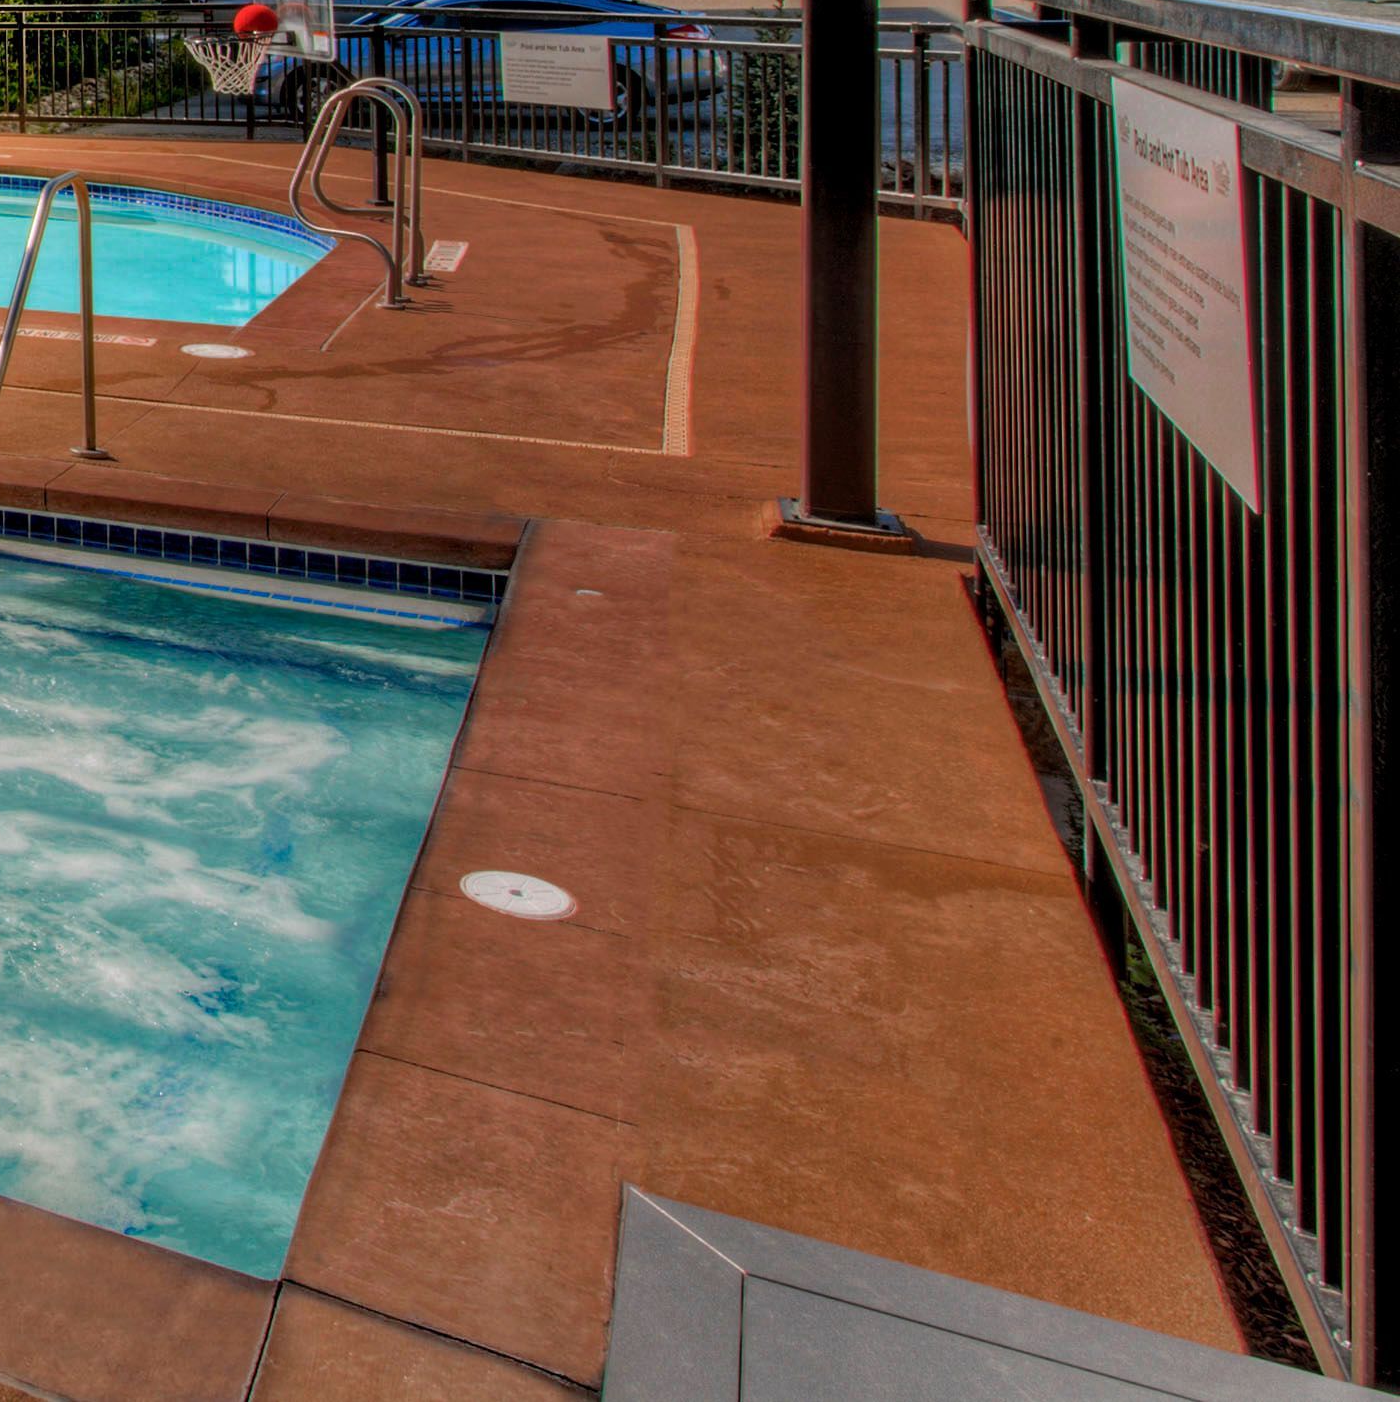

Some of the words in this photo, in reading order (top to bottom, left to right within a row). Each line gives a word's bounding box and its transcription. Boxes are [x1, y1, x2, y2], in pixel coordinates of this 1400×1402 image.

[1133, 128, 1148, 159] Pool
[1149, 139, 1161, 167] and
[1162, 142, 1175, 175] Hot
[1175, 149, 1190, 182] Tub
[1191, 157, 1209, 194] Area
